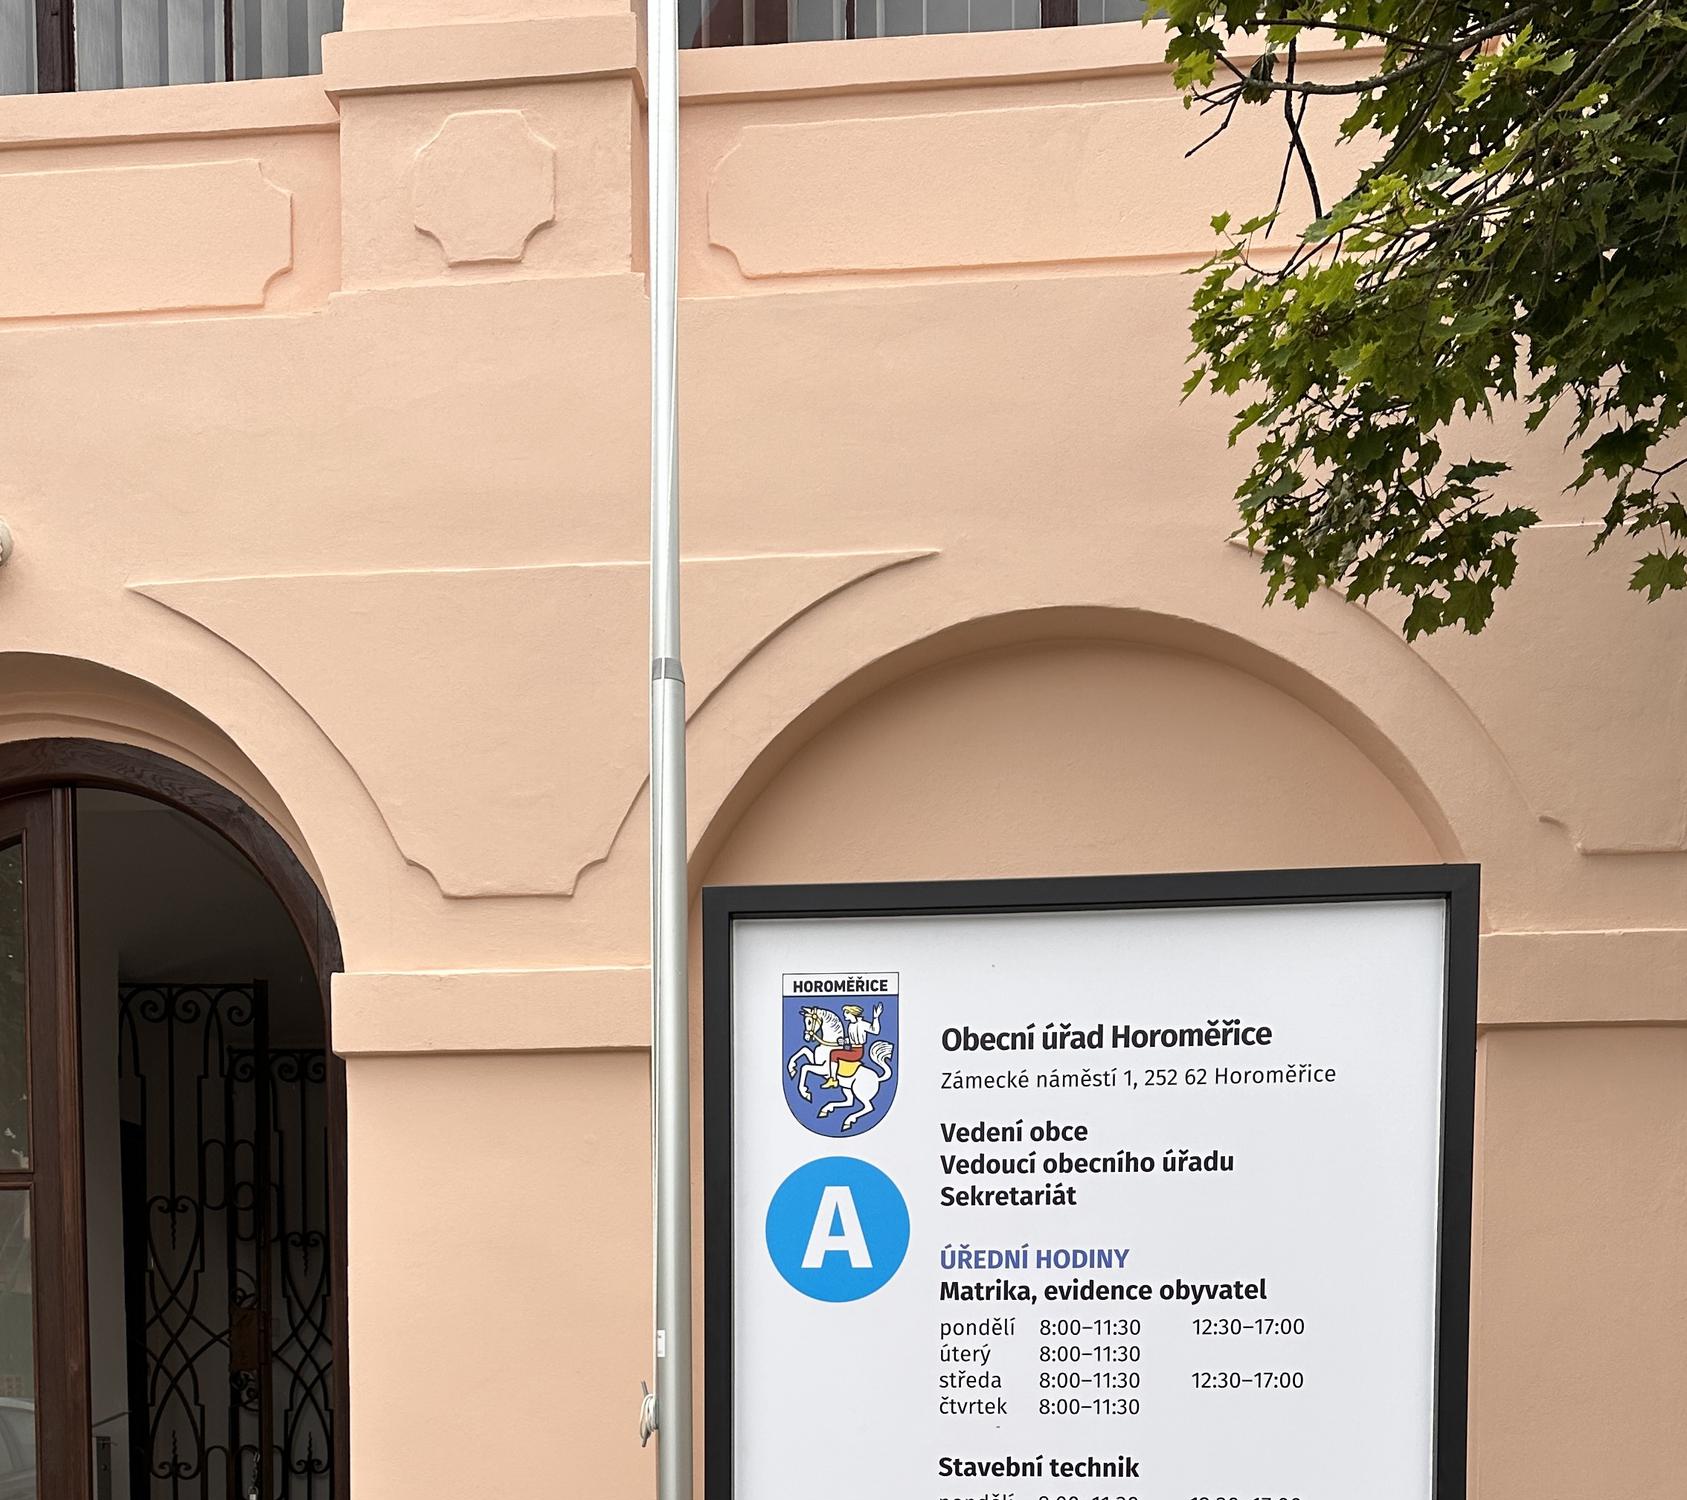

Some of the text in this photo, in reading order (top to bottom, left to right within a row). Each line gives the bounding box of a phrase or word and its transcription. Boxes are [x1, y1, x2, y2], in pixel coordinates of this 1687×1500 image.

[792, 975, 889, 994] HOROMĚŘICE
[941, 1018, 1273, 1052] Obecní úřad Horoměřice
[940, 1063, 1337, 1091] Zámecké náměstí 1, 252 62 Horoměřice
[939, 1118, 1089, 1144] Vedení obce
[939, 1148, 1234, 1175] Vedoucí obecního úřadu
[939, 1181, 1078, 1207] Sekretariát
[801, 1185, 873, 1269] A
[940, 1242, 1131, 1270] ÚŘEDNÍ HODINY
[939, 1277, 1268, 1306] Matrika, evidence obyvatel
[940, 1316, 1016, 1341] pondělí
[940, 1343, 992, 1367] úterý
[938, 1369, 1002, 1389] středa
[939, 1395, 1008, 1415] čtvrtek
[937, 1453, 1140, 1478] Stavební technik
